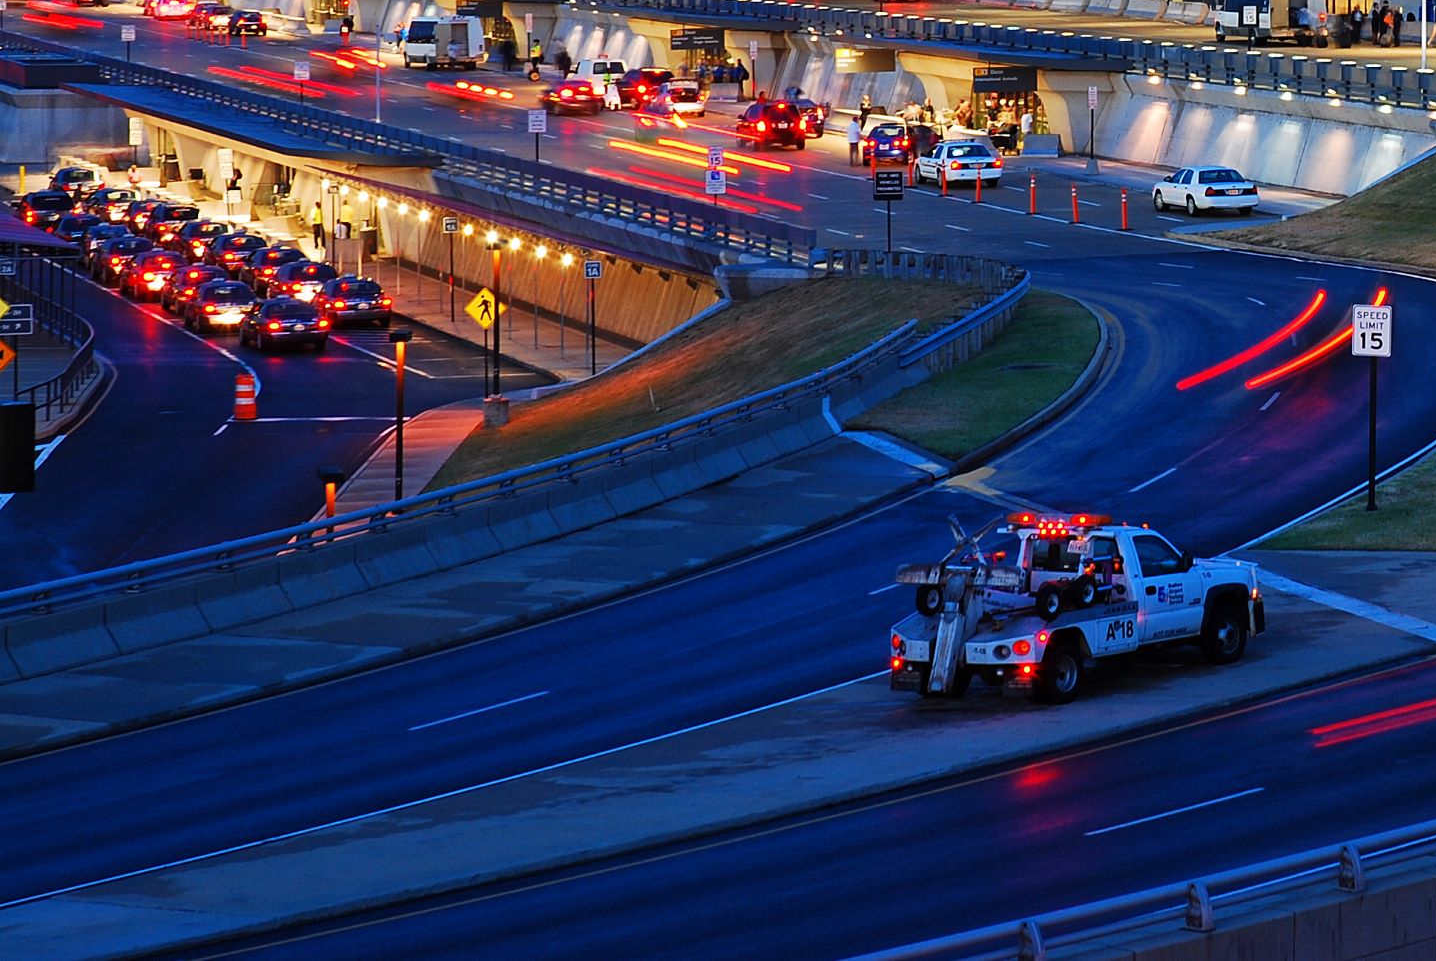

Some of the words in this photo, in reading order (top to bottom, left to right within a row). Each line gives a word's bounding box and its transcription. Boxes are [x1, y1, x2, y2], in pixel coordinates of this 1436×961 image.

[1246, 15, 1255, 23] 15
[710, 157, 720, 165] 15
[1, 265, 12, 273] 2A
[587, 267, 599, 276] 1A
[1357, 311, 1388, 320] SPEED
[1360, 332, 1383, 350] 15
